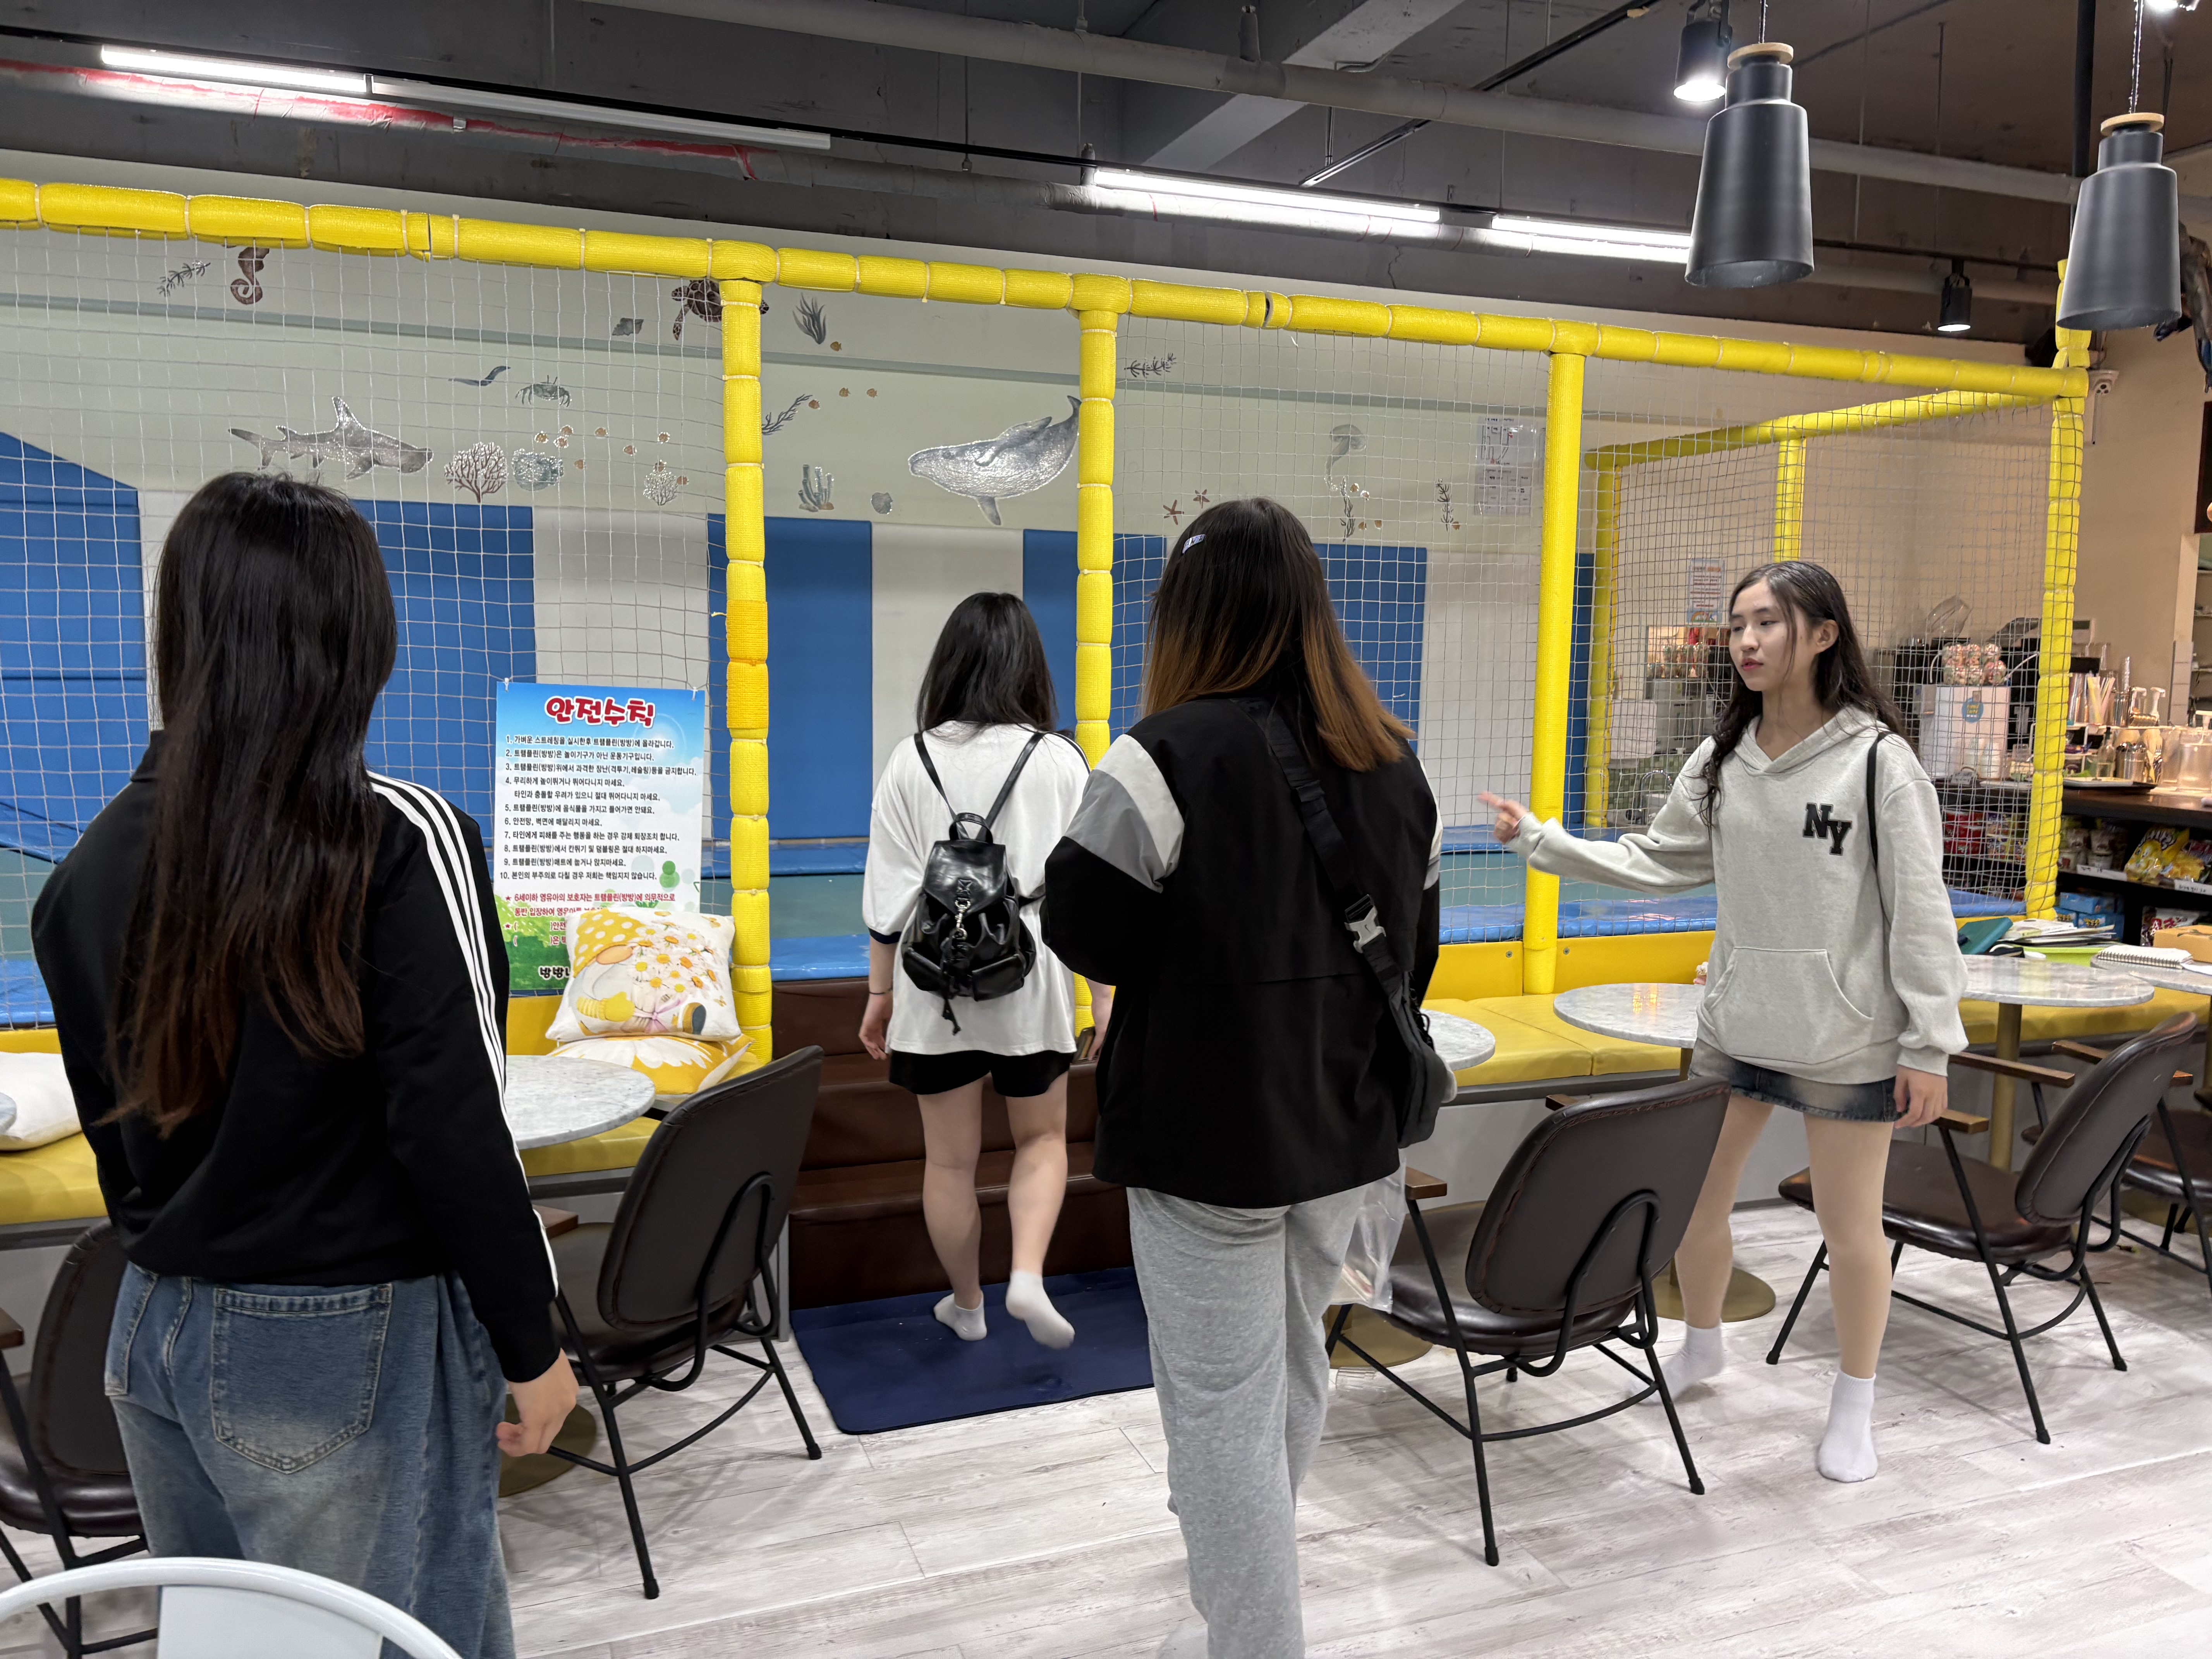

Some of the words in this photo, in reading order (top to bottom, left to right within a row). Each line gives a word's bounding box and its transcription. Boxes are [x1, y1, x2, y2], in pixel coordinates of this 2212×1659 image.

[546, 697, 654, 727] 안전수칙
[506, 735, 512, 744] 1.
[642, 740, 673, 748] 올라갑니다.
[610, 752, 654, 761] 운동기구입니다.
[514, 776, 538, 785] 무리하게
[573, 778, 603, 786] 뛰어다니지
[555, 791, 573, 799] 우려가
[609, 792, 638, 800] 뛰어다니지
[640, 793, 660, 801] 마세요.
[1802, 802, 1853, 856] NY
[660, 833, 679, 841] 합니다.
[514, 893, 538, 902] 6세이하
[540, 893, 565, 902] 영유아의
[567, 893, 592, 902] 보호자는
[644, 893, 675, 902] 의무적으로
[515, 908, 527, 916] 동반
[530, 907, 555, 916] 입장하여
